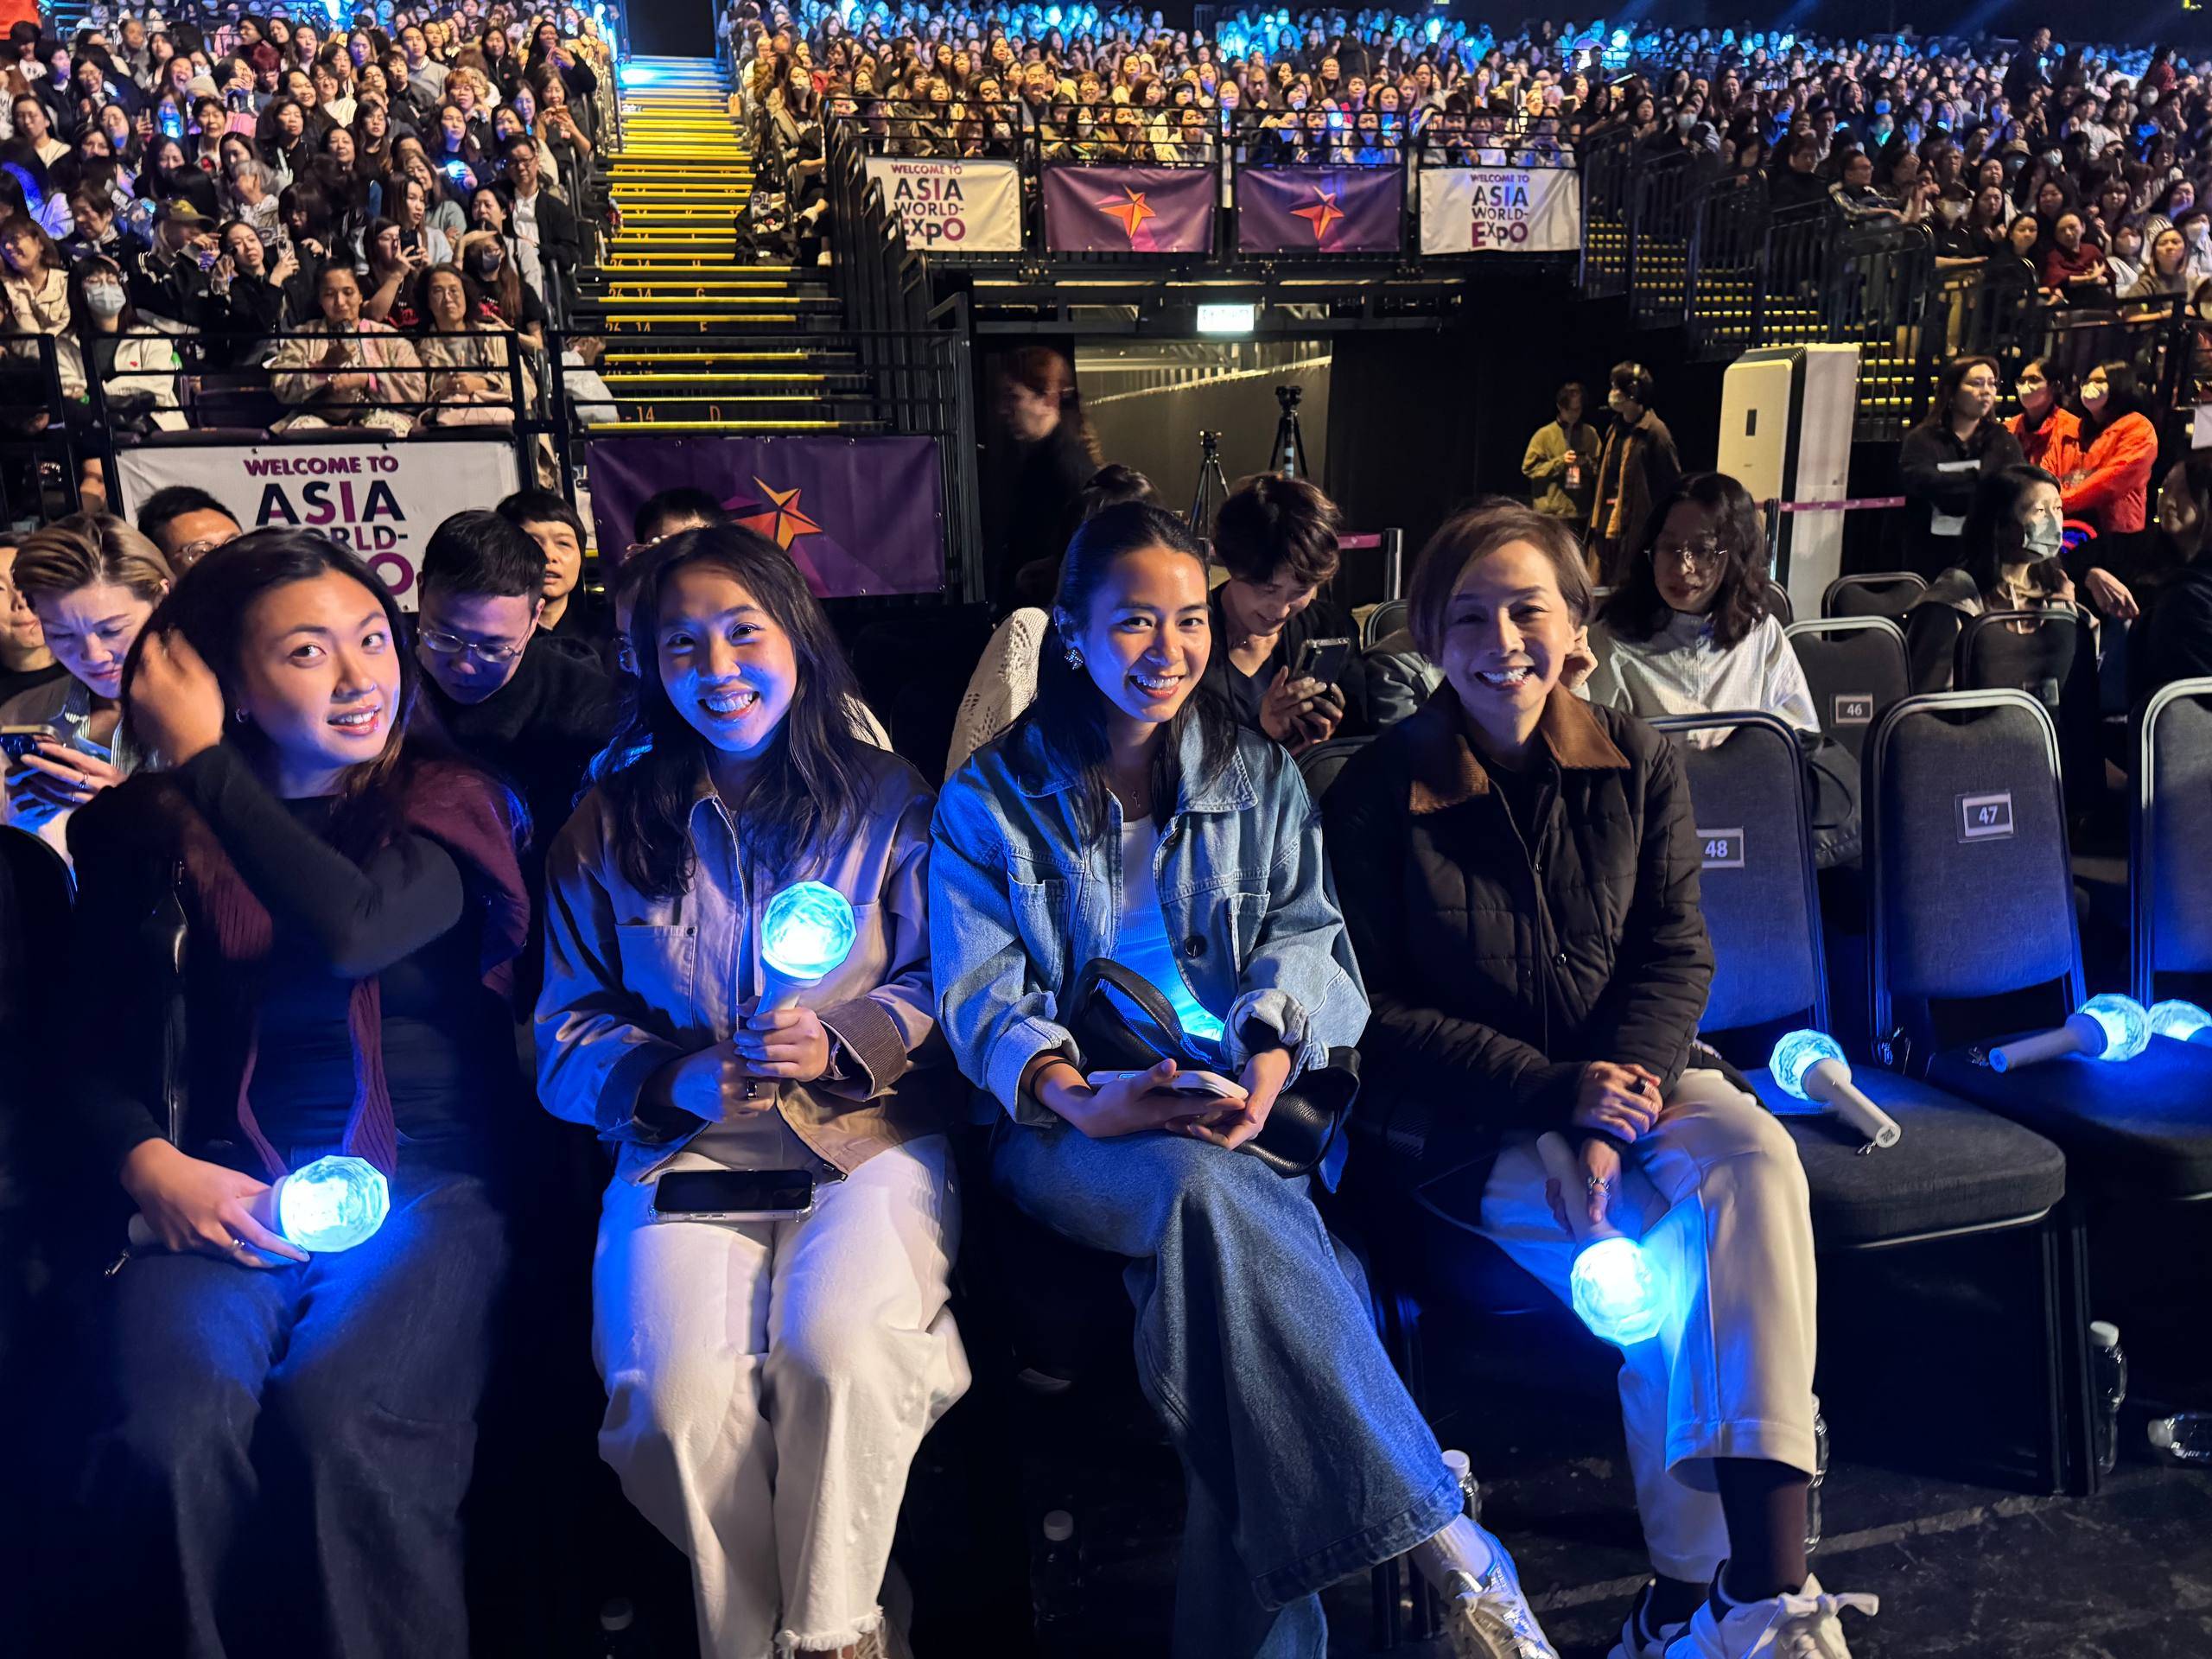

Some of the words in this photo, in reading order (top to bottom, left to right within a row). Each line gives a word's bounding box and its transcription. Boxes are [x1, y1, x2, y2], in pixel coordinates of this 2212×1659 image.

[891, 164, 945, 175] WELCOME
[950, 165, 963, 175] TO
[1471, 174, 1515, 183] WELCOME
[1517, 175, 1530, 183] TO
[893, 177, 964, 201] ASIA
[1471, 185, 1529, 207] ASIA
[893, 201, 964, 216] WORLD-
[1471, 207, 1529, 221] WORLD-
[1471, 221, 1529, 248] EXPO
[636, 405, 655, 423] 14
[709, 405, 721, 423] D
[243, 456, 362, 476] WELCOME
[366, 455, 399, 474] TO
[255, 480, 407, 526] ASIA
[1847, 703, 1863, 716] 46
[1979, 805, 1999, 825] 47
[1705, 839, 1728, 858] 48
